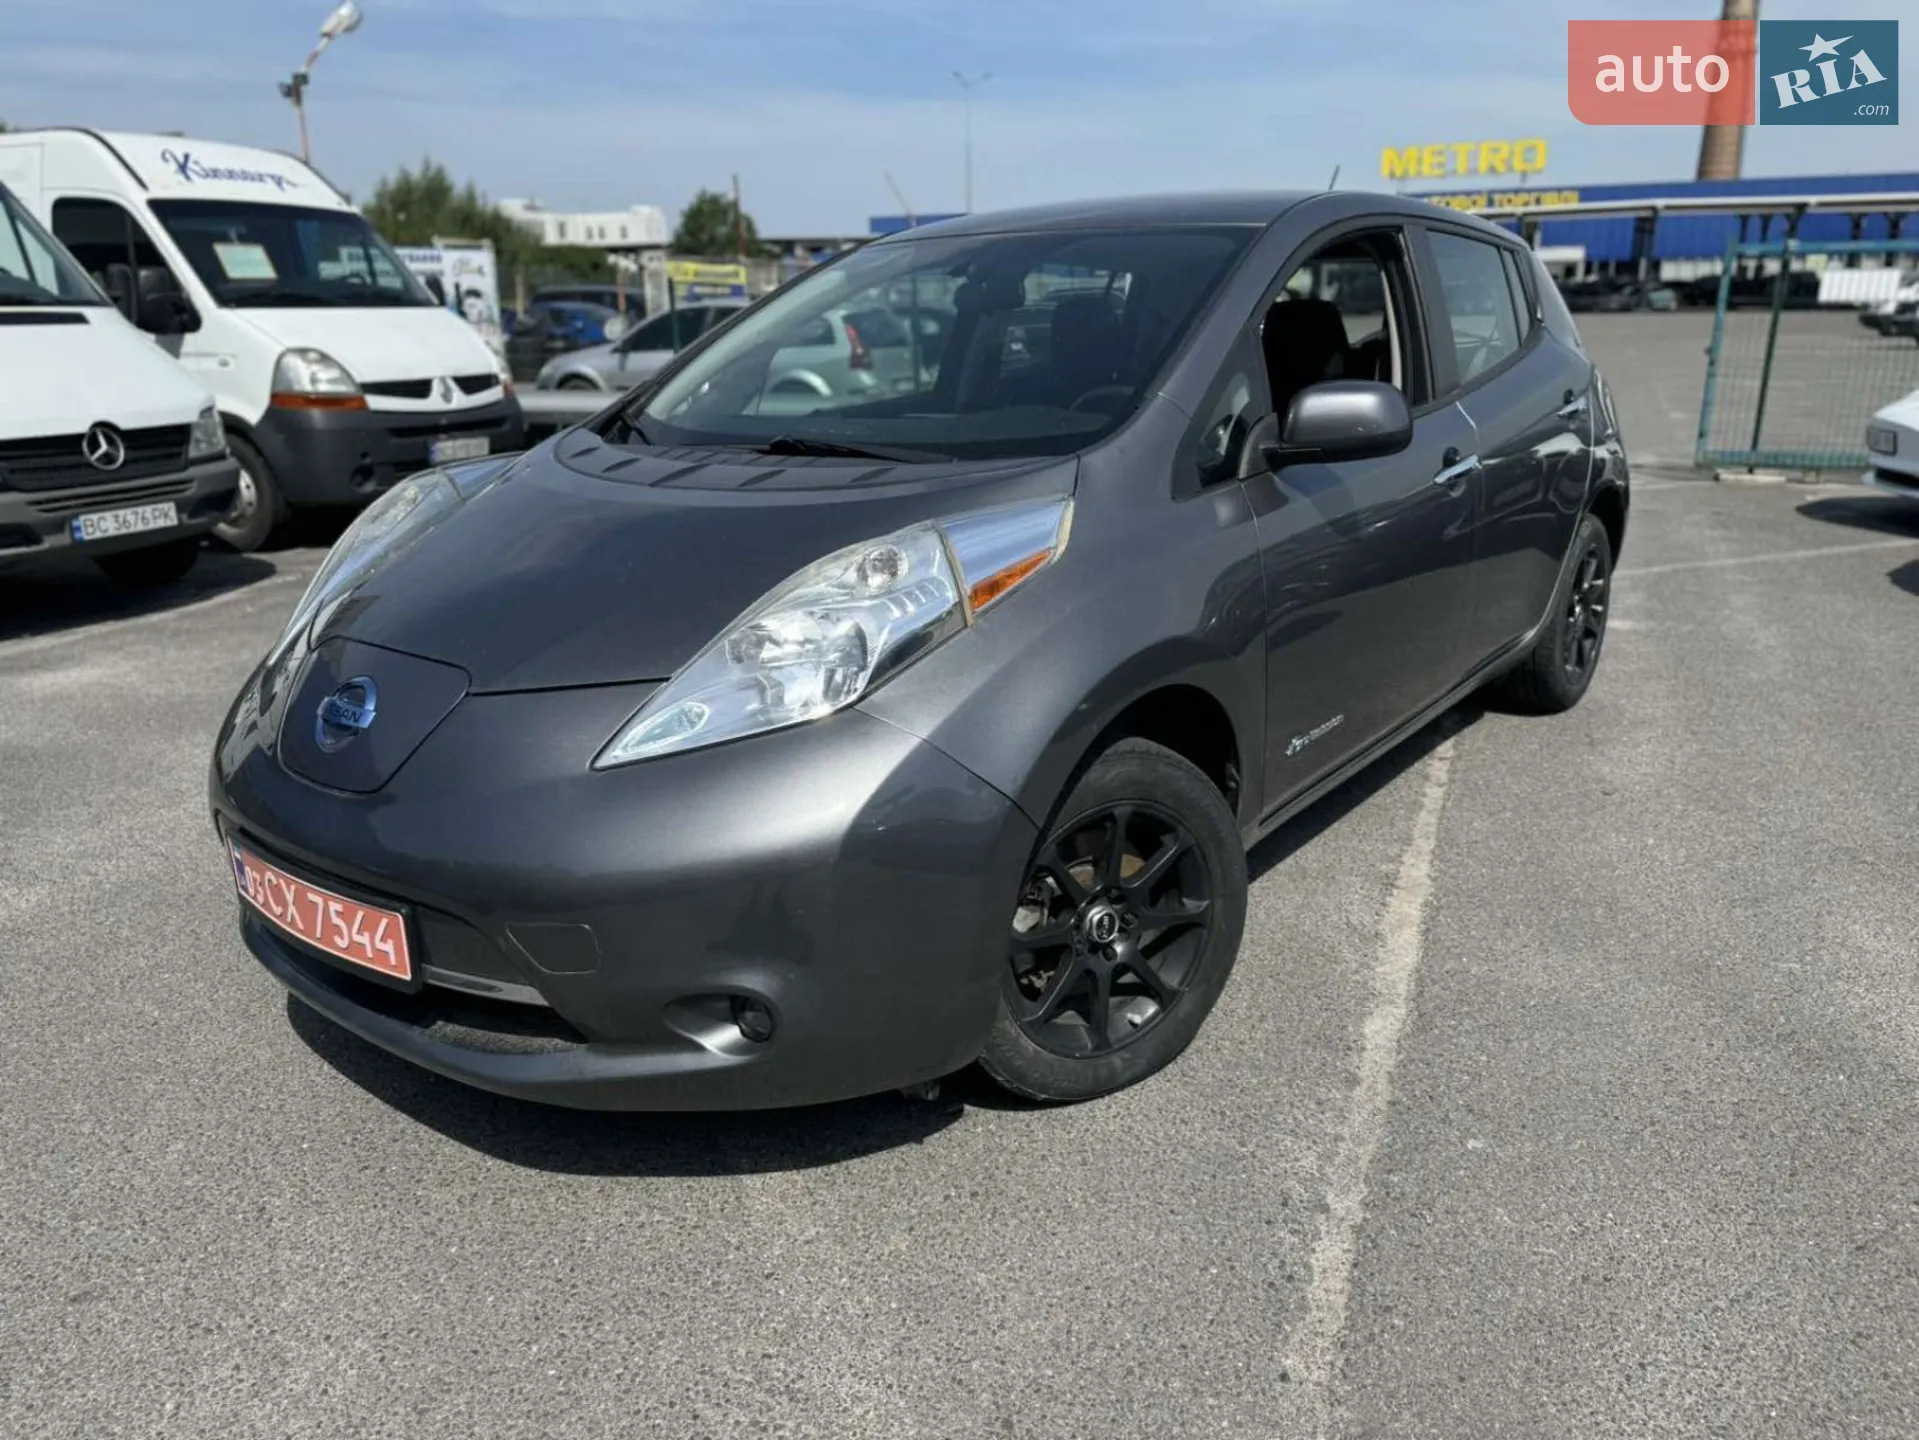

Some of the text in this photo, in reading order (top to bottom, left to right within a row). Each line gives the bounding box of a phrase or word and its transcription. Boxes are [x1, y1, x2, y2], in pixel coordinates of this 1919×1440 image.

[1380, 136, 1548, 178] METRO
[111, 509, 150, 532] 3676
[306, 891, 398, 967] 7544
